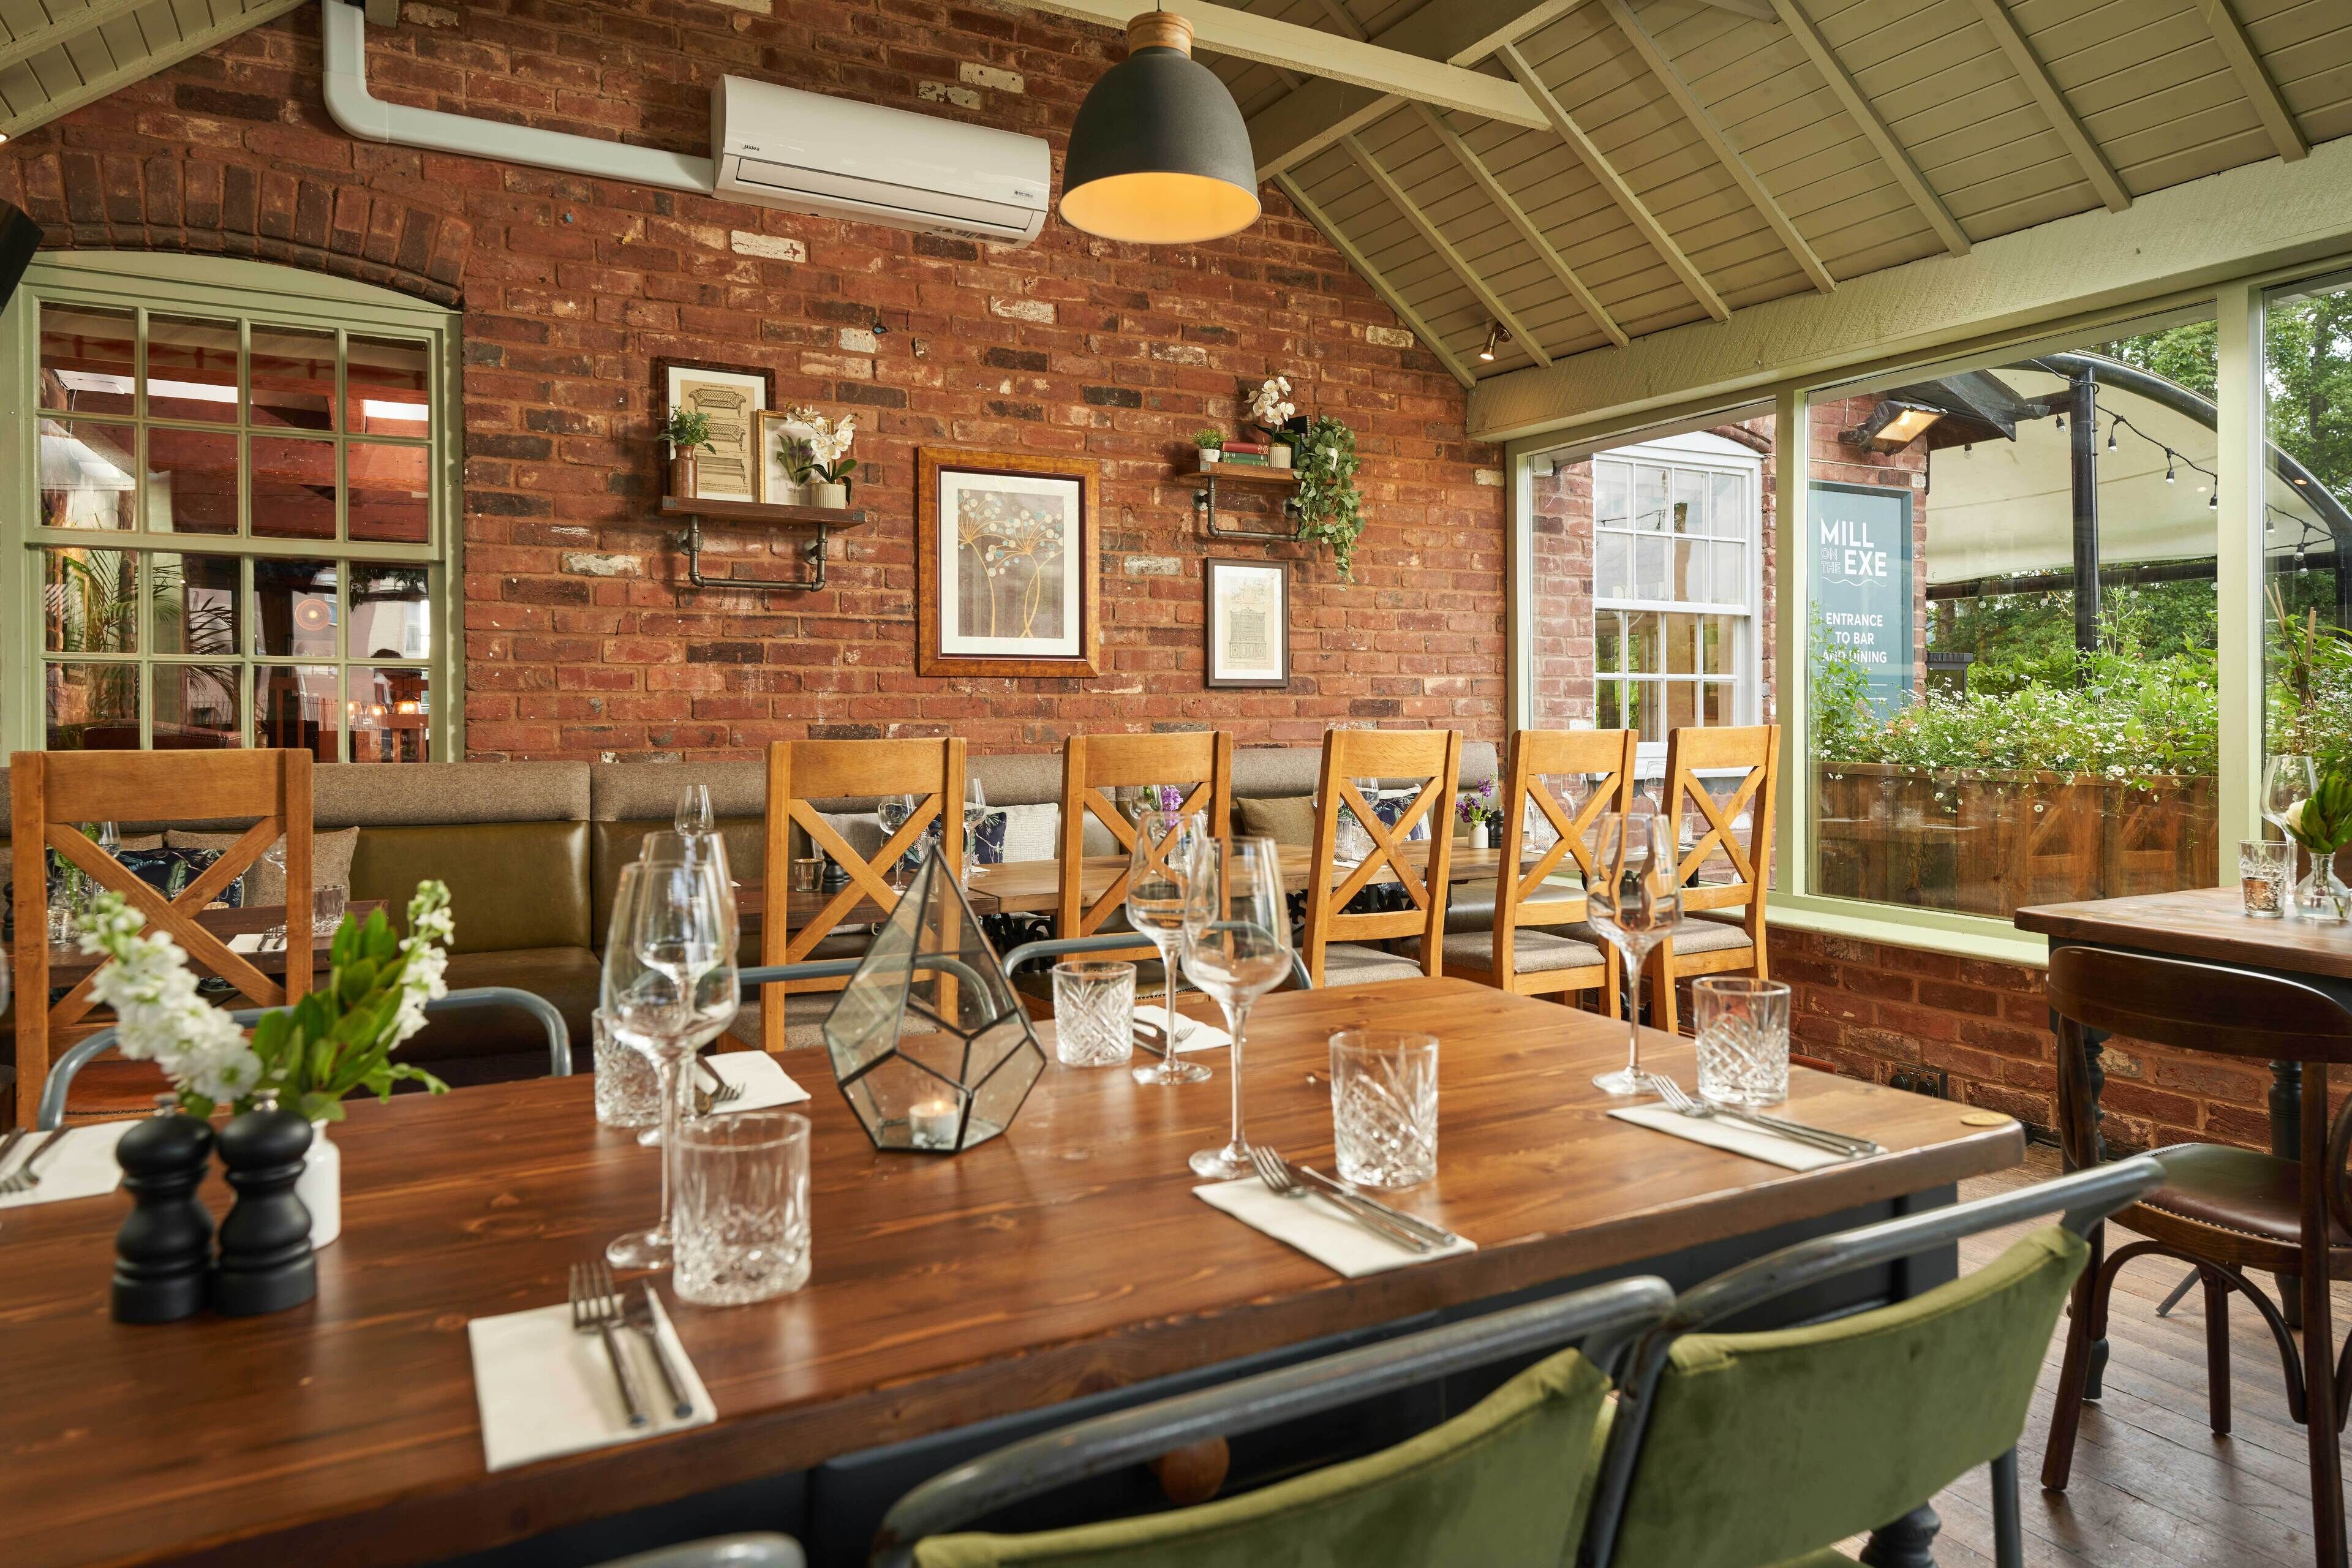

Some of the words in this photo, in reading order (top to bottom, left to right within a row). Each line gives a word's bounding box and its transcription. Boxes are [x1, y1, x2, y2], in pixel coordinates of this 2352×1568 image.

[1821, 517, 1874, 548] MILL
[1821, 548, 1838, 560] ON
[1821, 560, 1841, 573] THE
[1844, 549, 1887, 576] EXE
[1826, 612, 1883, 627] ENTRANCE
[1835, 631, 1850, 644] TO
[1853, 632, 1874, 645] BAR
